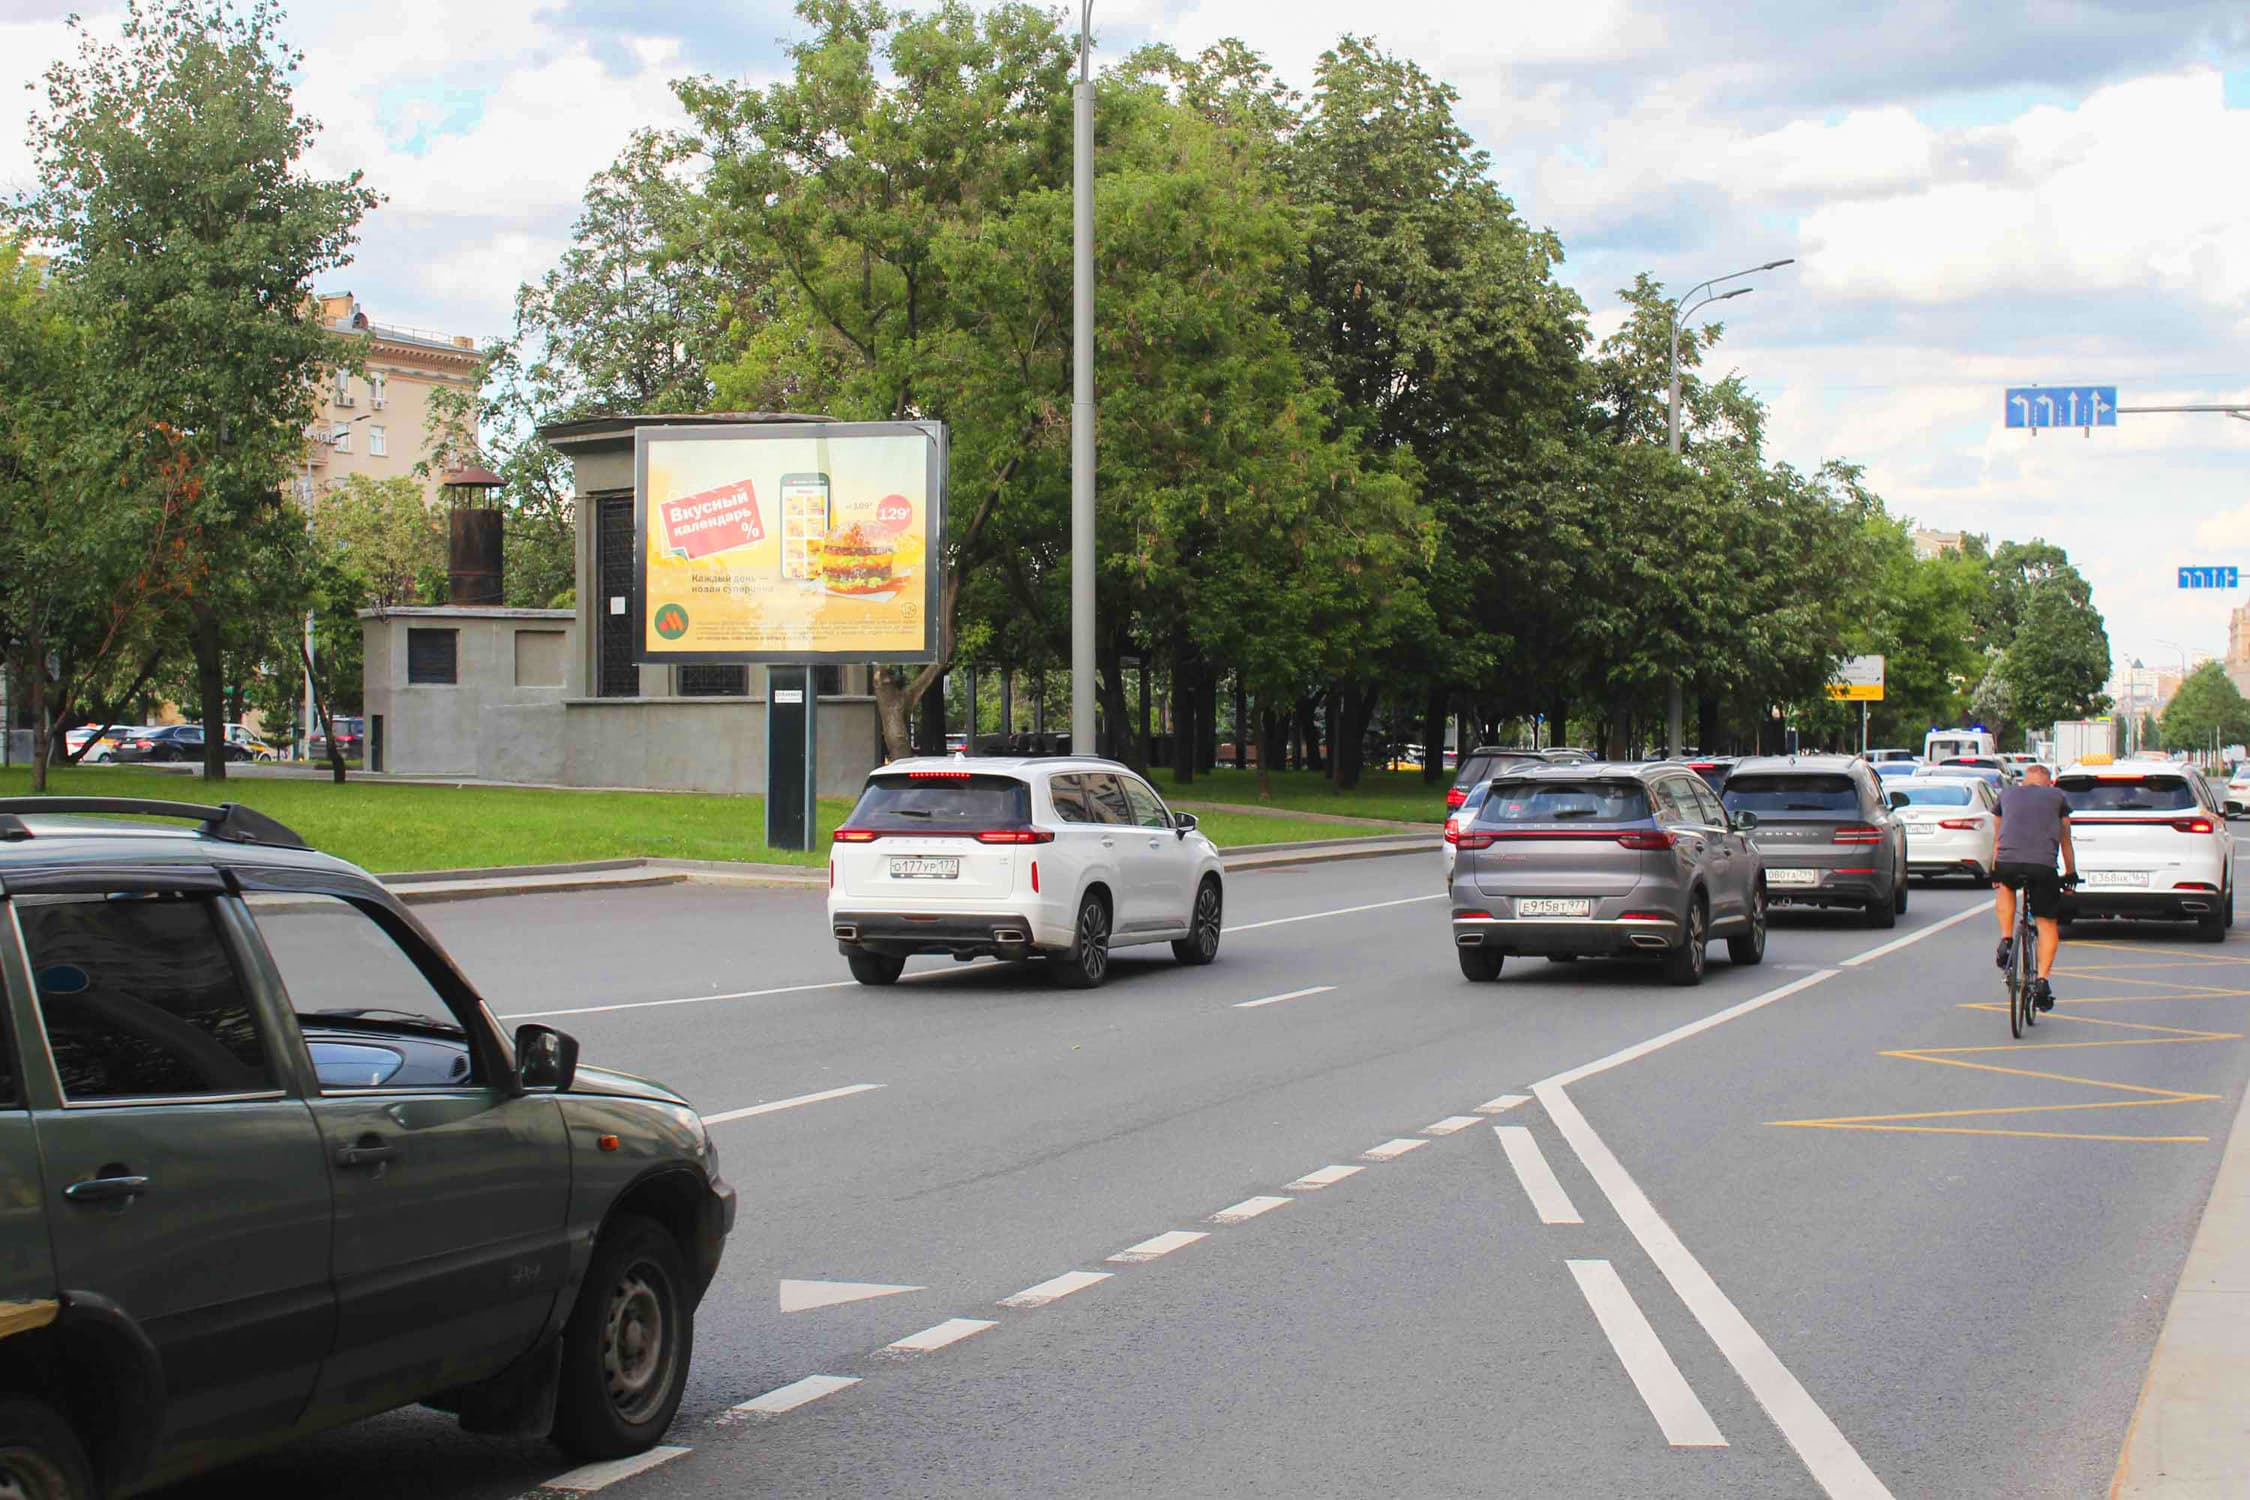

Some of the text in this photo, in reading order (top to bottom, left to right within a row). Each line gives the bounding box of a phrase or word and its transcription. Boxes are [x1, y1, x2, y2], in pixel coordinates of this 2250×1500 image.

[669, 487, 749, 523] Вкусный
[673, 508, 752, 537] календарь
[691, 574, 731, 583] Каждый
